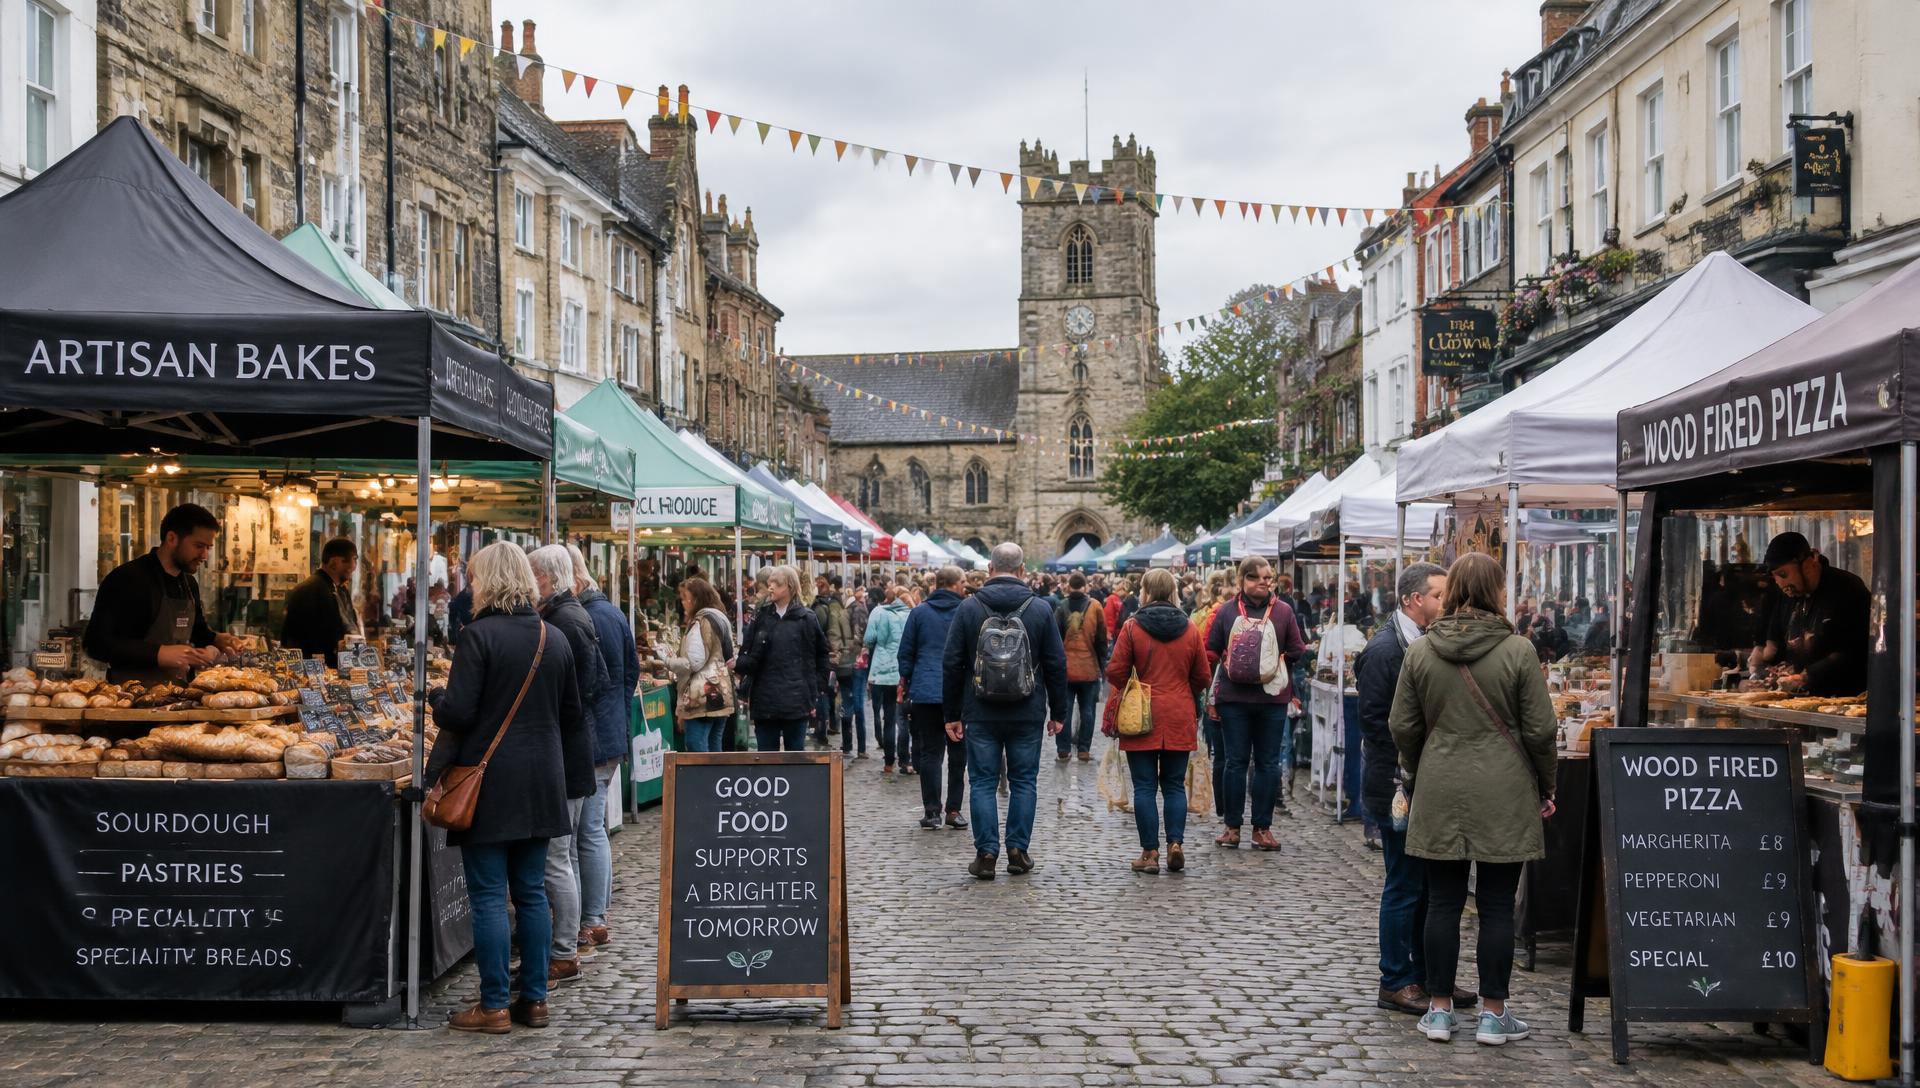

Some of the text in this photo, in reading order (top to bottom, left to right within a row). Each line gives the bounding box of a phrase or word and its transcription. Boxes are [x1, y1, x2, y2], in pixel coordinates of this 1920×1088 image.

[24, 340, 375, 380] ARTISAN BAKES
[1643, 371, 1848, 466] WOOD FIRED PIZZA
[1621, 756, 1777, 777] WOOD FIRED
[716, 777, 789, 798] GOOD
[1664, 788, 1742, 810] PIZZA
[97, 812, 269, 834] SOURDOUGH
[718, 811, 787, 832] FOOD
[1622, 834, 1782, 850] MARGHERITA £8
[696, 848, 807, 867] SUPPORTS
[122, 863, 242, 883] PASTRIES
[1625, 873, 1786, 889] PEPPERONI £9
[685, 882, 817, 902] A BRIGHTER
[684, 918, 818, 938] TOMORROW
[1626, 911, 1790, 928] VEGETARIAN £9
[207, 948, 291, 966] BREADS
[1630, 951, 1795, 968] SPECIAL £10
